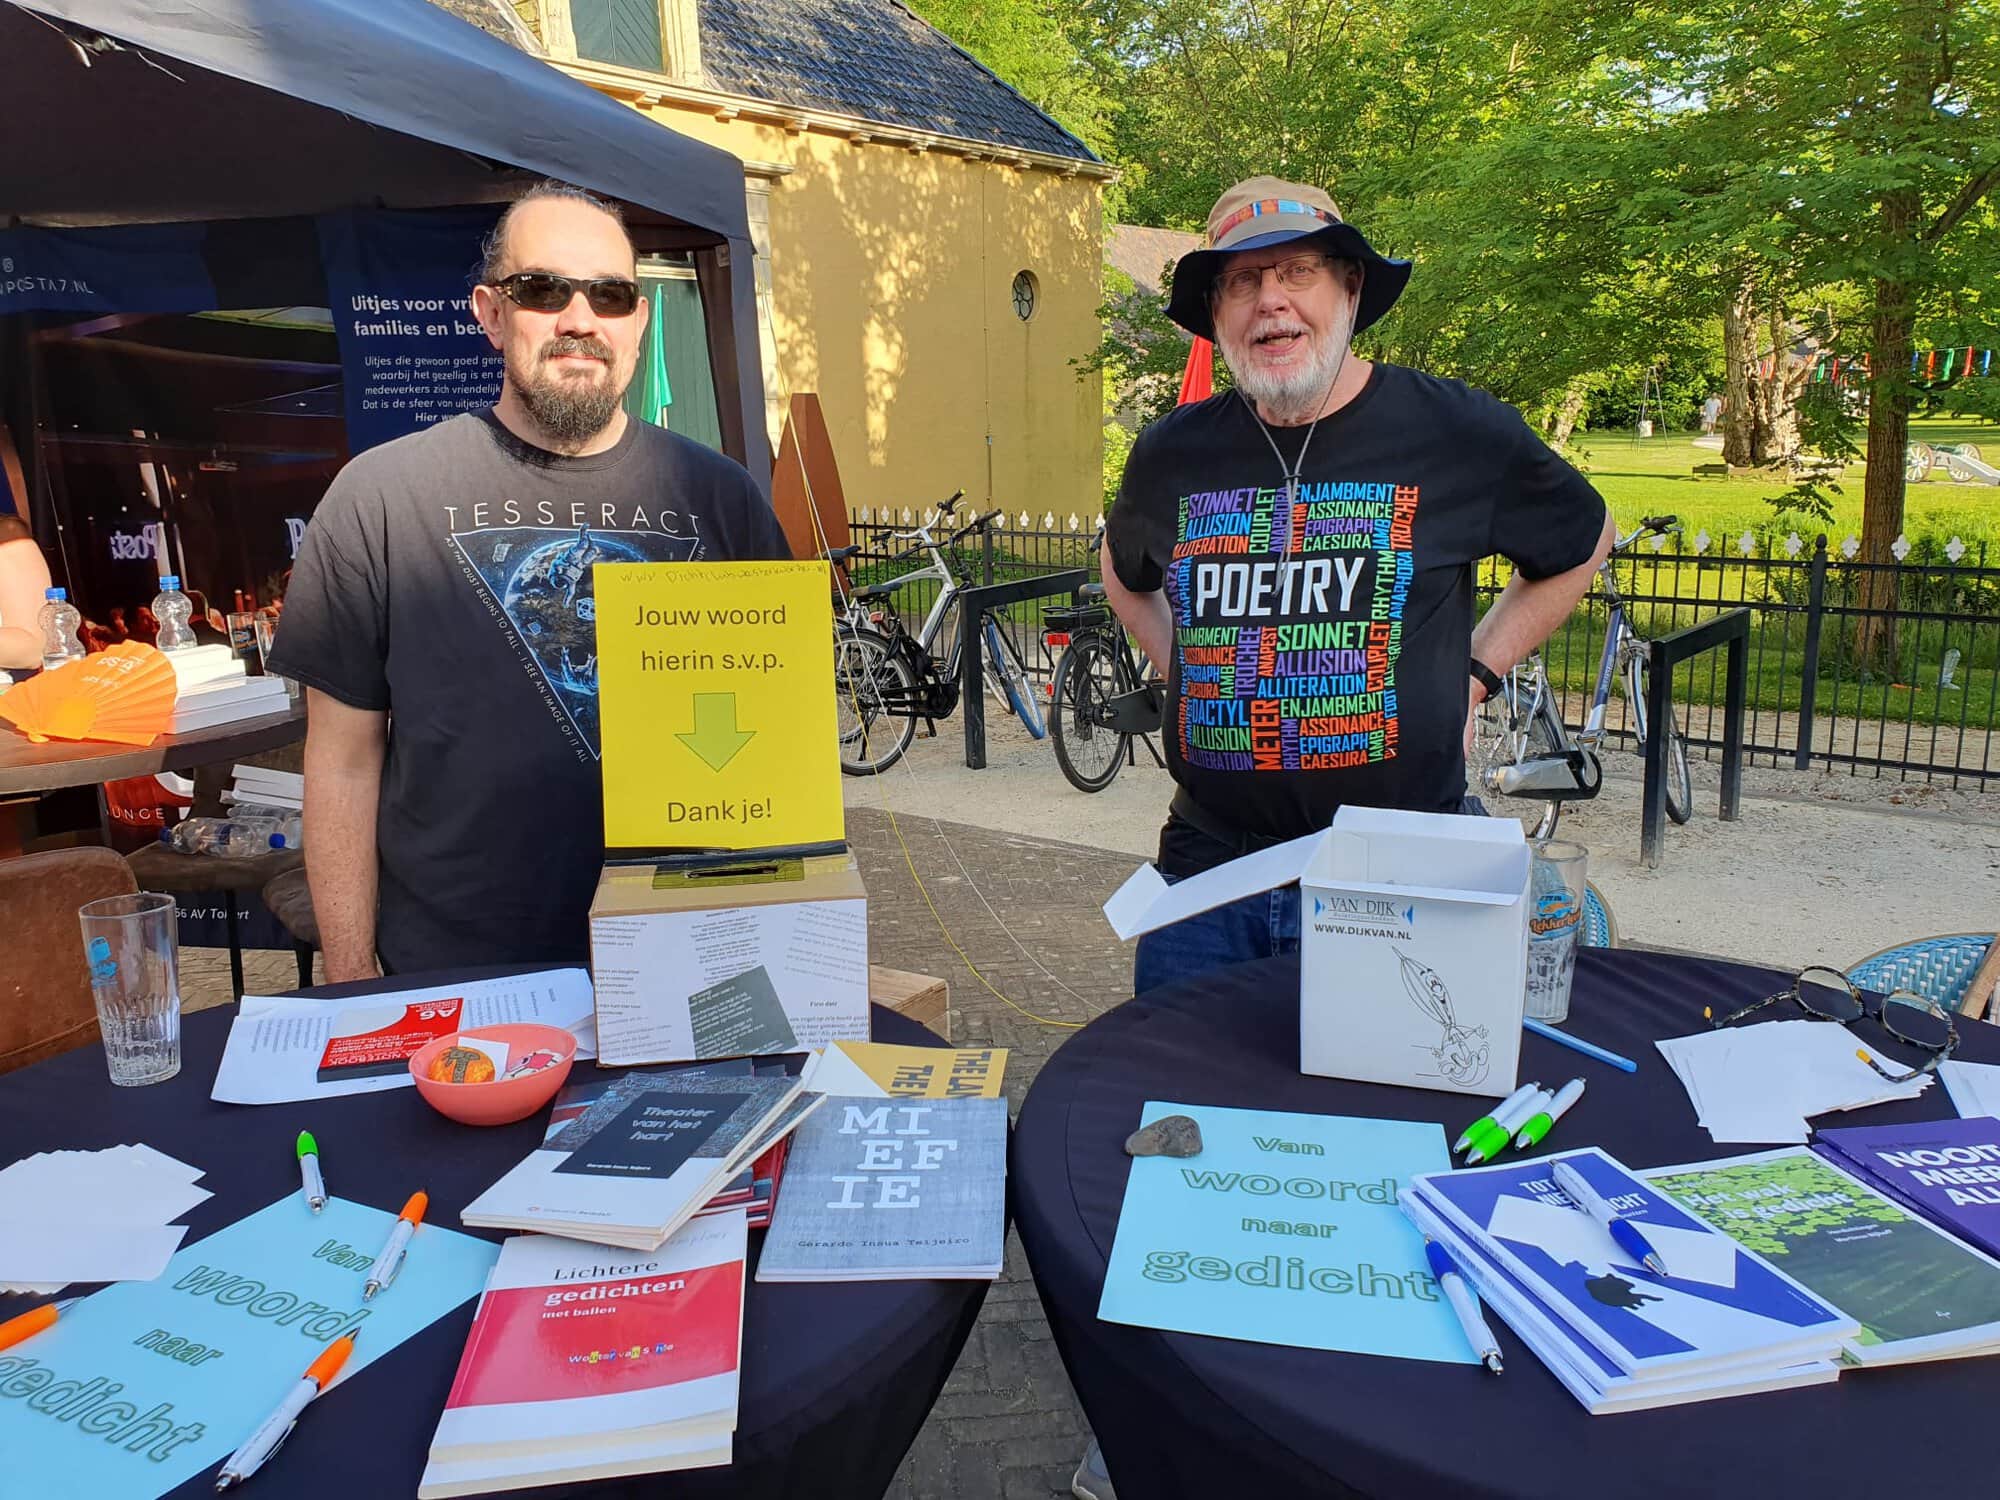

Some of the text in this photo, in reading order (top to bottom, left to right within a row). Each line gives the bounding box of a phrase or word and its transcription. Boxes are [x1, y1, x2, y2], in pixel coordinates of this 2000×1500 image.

[352, 295, 473, 314] Uitjes voor vri
[354, 320, 421, 336] families
[426, 324, 448, 335] en
[364, 355, 391, 368] Uitjes
[395, 355, 411, 366] die
[415, 357, 450, 368] gewoon
[453, 355, 478, 368] goed
[372, 370, 410, 382] waarbij
[413, 370, 430, 379] het
[432, 370, 467, 382] gezellig
[470, 371, 478, 379] is
[365, 384, 500, 396] medewerkers zich vriendelijk
[363, 400, 378, 410] Dat
[381, 400, 389, 409] is
[392, 399, 406, 409] de
[409, 399, 434, 409] sfeer
[415, 413, 438, 422] Hier
[1188, 487, 1258, 519] SONNET
[1294, 482, 1396, 504] ENJAMBMENT
[444, 500, 700, 535] TESSERACT
[1177, 496, 1190, 543] ANAPEST
[1249, 487, 1276, 554] COUPLET
[1306, 502, 1393, 520] ASSONANCE
[1391, 484, 1419, 551] TROCHEE
[1185, 512, 1253, 541] ALLUSION
[1305, 518, 1374, 536] EPIGRAPH
[1372, 519, 1392, 550] IAMB
[1303, 534, 1372, 552] CAESURA
[1176, 555, 1194, 627] ANAPHORA
[1196, 557, 1365, 618] POETRY
[1371, 550, 1396, 621] RHYTHM
[1388, 551, 1413, 620] ANAPHORA
[635, 604, 787, 626] Jouw woord
[1176, 627, 1239, 647] NJAMBMENT
[1276, 621, 1370, 651] SONNET
[453, 548, 465, 562] THE
[463, 567, 480, 587] DUST
[475, 586, 498, 617] BEGINS
[497, 616, 508, 629] TO
[504, 628, 519, 651] FALL
[523, 661, 539, 679] SEE
[535, 680, 547, 694] AN
[543, 694, 565, 724] IMAGE
[560, 723, 575, 740] OF
[568, 736, 580, 748] IT
[574, 746, 590, 763] ALL
[641, 650, 784, 673] hierin s.v.p.
[1235, 626, 1261, 699] TROCHEE
[1258, 626, 1278, 677] ANAPEST
[1274, 649, 1367, 678] ALLUSION
[1366, 621, 1390, 692] COUPLET
[1220, 665, 1236, 699] IAMB
[1257, 674, 1367, 699] ALLITERATION
[1192, 699, 1250, 727] DACTYL
[1280, 691, 1384, 719] ENJAMBMENT
[1383, 689, 1398, 719] FOOT
[1250, 700, 1283, 771] METER
[1300, 711, 1385, 737] ASSONANCE
[1192, 725, 1251, 751] ALLUSION
[1280, 718, 1300, 770] RHYTHM
[1300, 732, 1369, 755] EPIGRAPH
[1368, 730, 1385, 763] IAMB
[1300, 750, 1368, 770] CAESURA
[667, 798, 772, 824] Dank je!
[190, 908, 206, 920] AV
[210, 908, 250, 920] Tolrt
[1331, 897, 1359, 913] VAN
[1366, 900, 1397, 917] DIJK
[1314, 923, 1413, 941] WWW.DIJKVAN.NL
[419, 1008, 457, 1020] A6
[327, 1051, 402, 1067] NOTEBOOK
[951, 1051, 992, 1074] THE
[891, 1065, 935, 1088] THE
[632, 1119, 703, 1129] van het
[641, 1106, 716, 1118] Theater
[838, 1105, 932, 1135] MI
[629, 1131, 675, 1142] hart
[1252, 1136, 1326, 1157] Van
[857, 1139, 958, 1170] EF
[1875, 1144, 2000, 1168] NOOIT
[826, 1175, 921, 1209] IE
[1180, 1168, 1401, 1206] woord
[1519, 1179, 1558, 1194] TOT
[1535, 1191, 1649, 1212] NIE ICHT
[1241, 1216, 1340, 1239] naar
[312, 1238, 377, 1273] Van
[798, 1239, 854, 1248] Gerardo
[554, 1261, 659, 1281] Lichtere
[1141, 1250, 1441, 1302] gedicht
[172, 1265, 371, 1342] woord
[543, 1278, 686, 1307] gedichten
[542, 1306, 617, 1319] met ballen
[133, 1328, 225, 1368] naar
